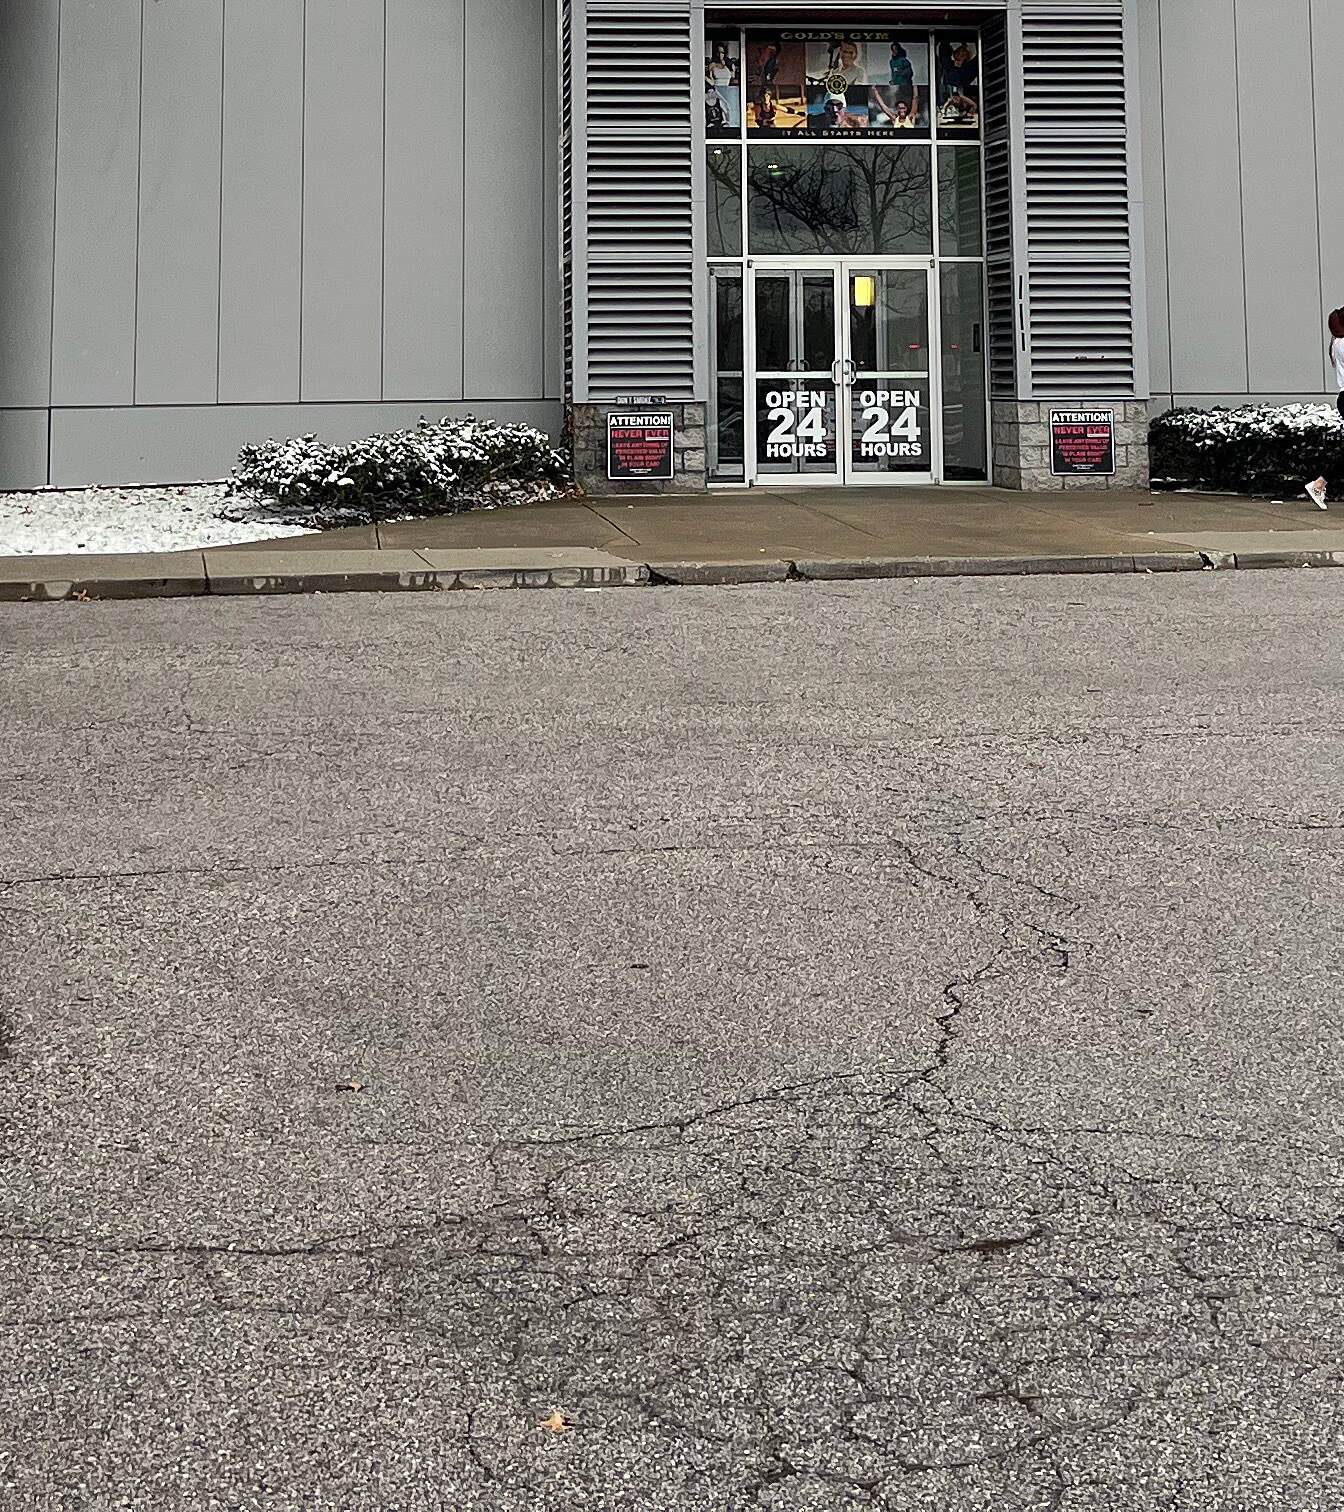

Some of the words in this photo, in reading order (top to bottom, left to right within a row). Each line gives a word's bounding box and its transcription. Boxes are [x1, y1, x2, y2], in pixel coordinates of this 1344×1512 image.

[780, 32, 845, 40] GOLD'S
[849, 32, 890, 40] GYM
[765, 391, 826, 408] OPEN
[859, 390, 920, 407] OPEN
[610, 416, 671, 426] ATTENTION!
[861, 406, 921, 442] 24
[1052, 413, 1112, 422] ATTENTION!
[766, 407, 827, 443] 24
[1053, 426, 1085, 434] NEVER
[1087, 426, 1110, 434] EVER
[611, 429, 643, 438] NEVER
[645, 429, 669, 438] EVER
[766, 443, 827, 457] HOURS
[861, 442, 922, 457] HOURS
